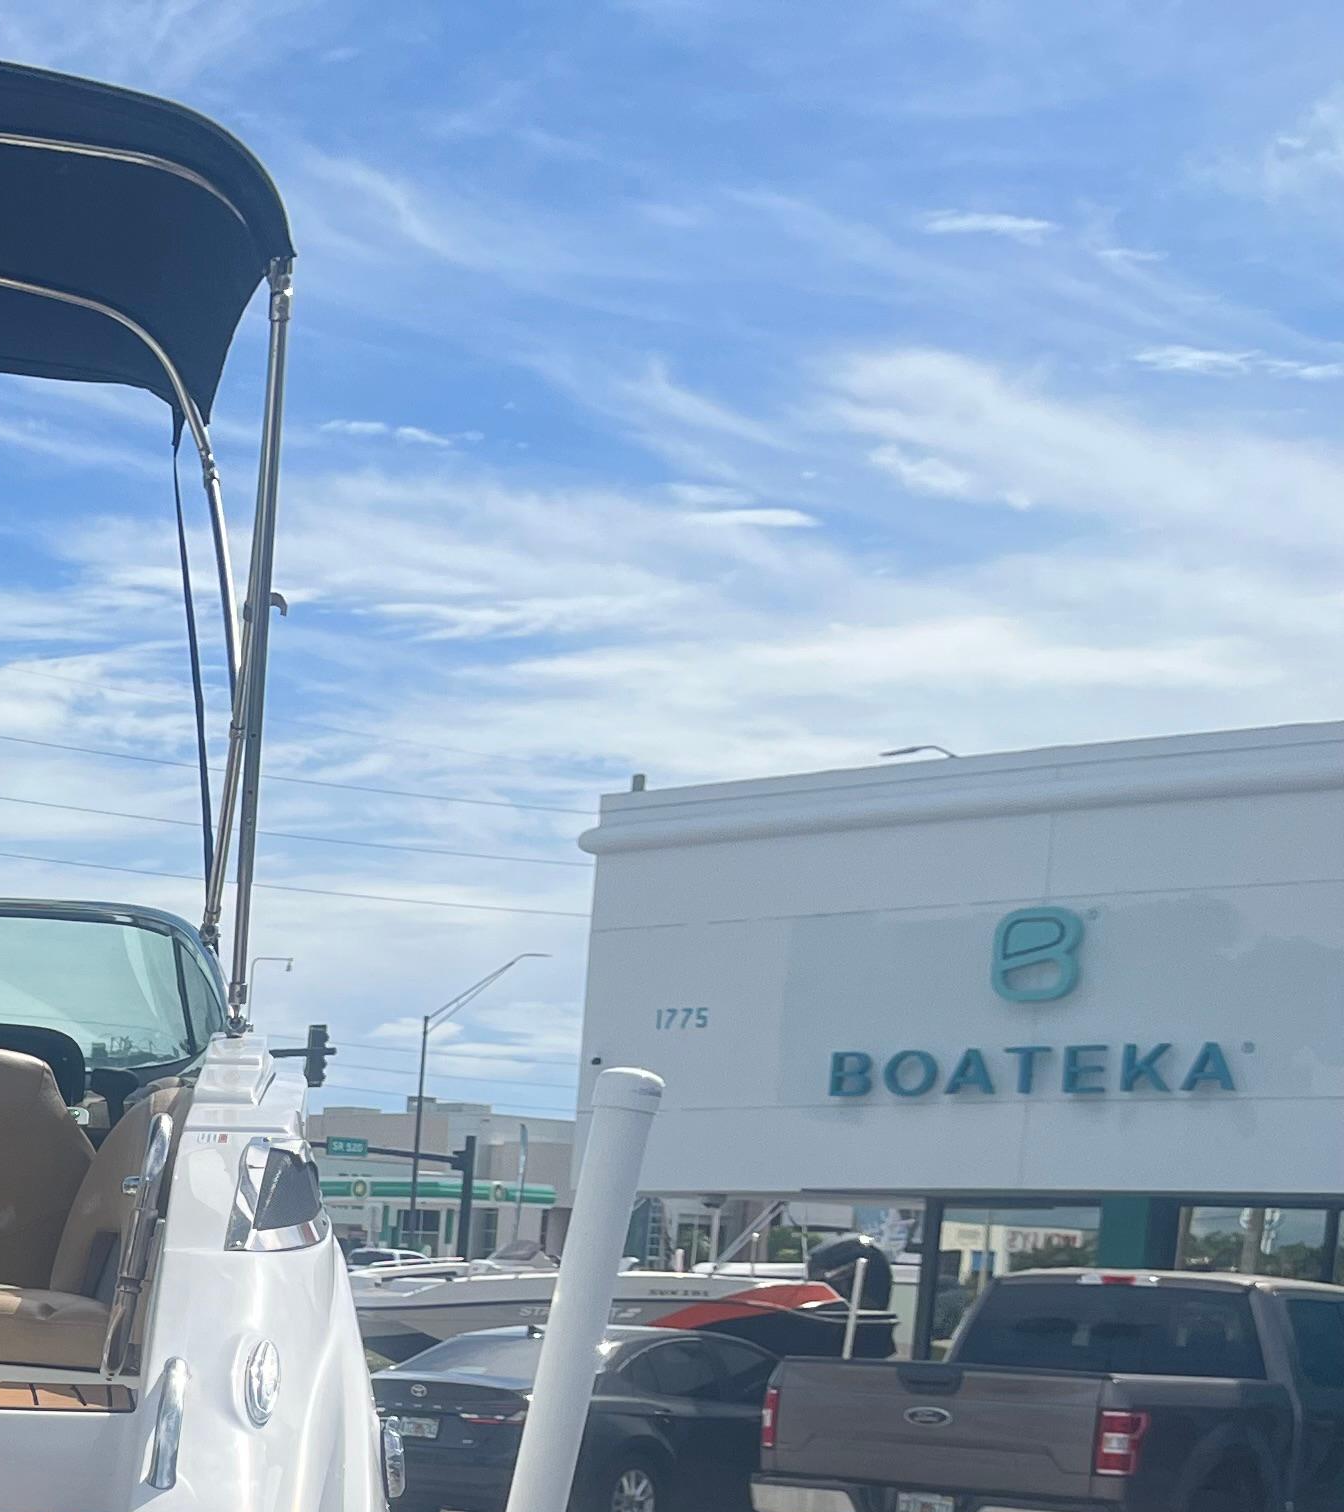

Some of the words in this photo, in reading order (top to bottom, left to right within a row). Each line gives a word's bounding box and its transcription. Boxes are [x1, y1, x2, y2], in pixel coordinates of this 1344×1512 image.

[655, 1007, 709, 1030] 1775
[829, 1041, 1237, 1098] BOATEKA
[331, 1141, 345, 1152] SR
